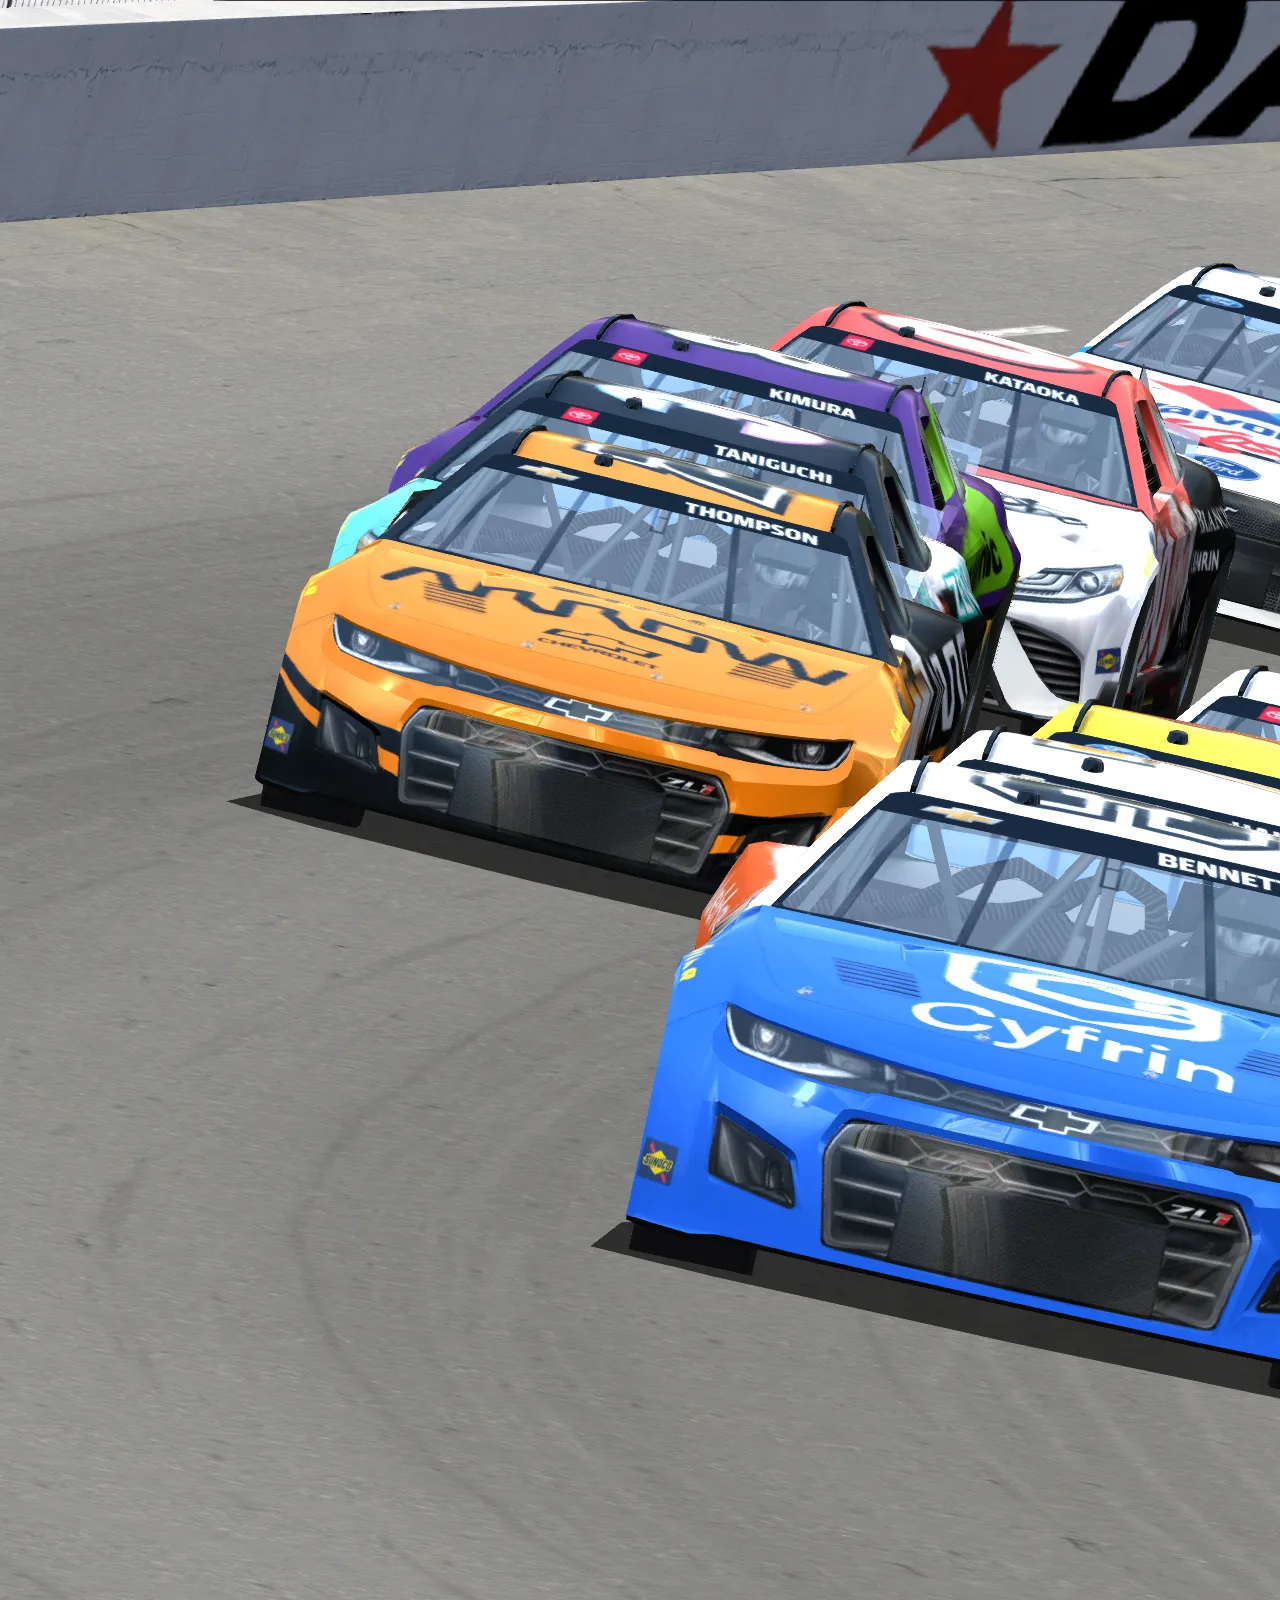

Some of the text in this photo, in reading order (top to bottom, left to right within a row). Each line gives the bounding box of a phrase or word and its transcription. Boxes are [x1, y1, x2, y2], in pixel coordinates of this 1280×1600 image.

[769, 388, 857, 420] KIMURA
[984, 371, 1081, 406] KATAOKA
[714, 444, 833, 485] TANIGUCHI
[684, 501, 819, 546] THOMPSON
[537, 637, 660, 670] CHEVROLET
[911, 1002, 1235, 1094] Cyfrin
[1163, 1203, 1234, 1226] ZL1
